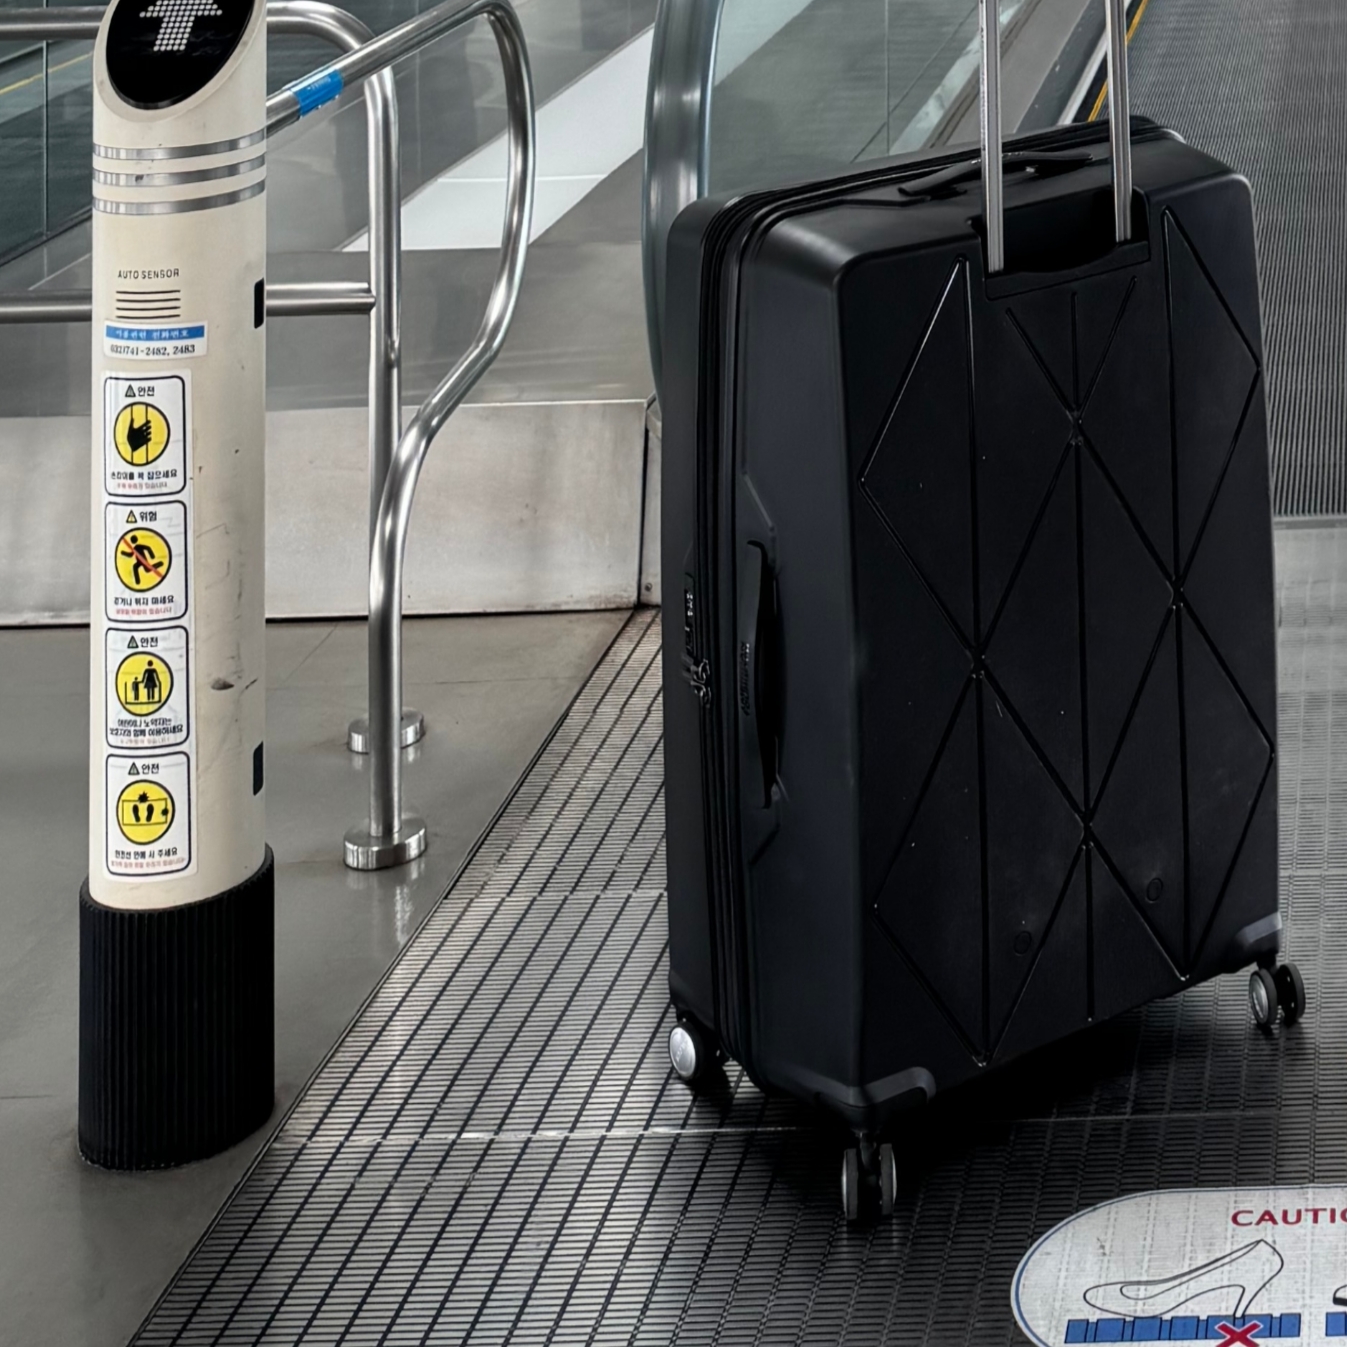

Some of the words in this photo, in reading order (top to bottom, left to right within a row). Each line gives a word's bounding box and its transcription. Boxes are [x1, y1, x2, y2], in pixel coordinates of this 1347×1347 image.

[117, 269, 139, 279] AUTO
[141, 268, 180, 279] SENSOR
[173, 344, 195, 355] 2483
[137, 385, 155, 397] 안전
[139, 511, 157, 522] 위험
[140, 636, 158, 648] 안전
[141, 763, 159, 775] 안전
